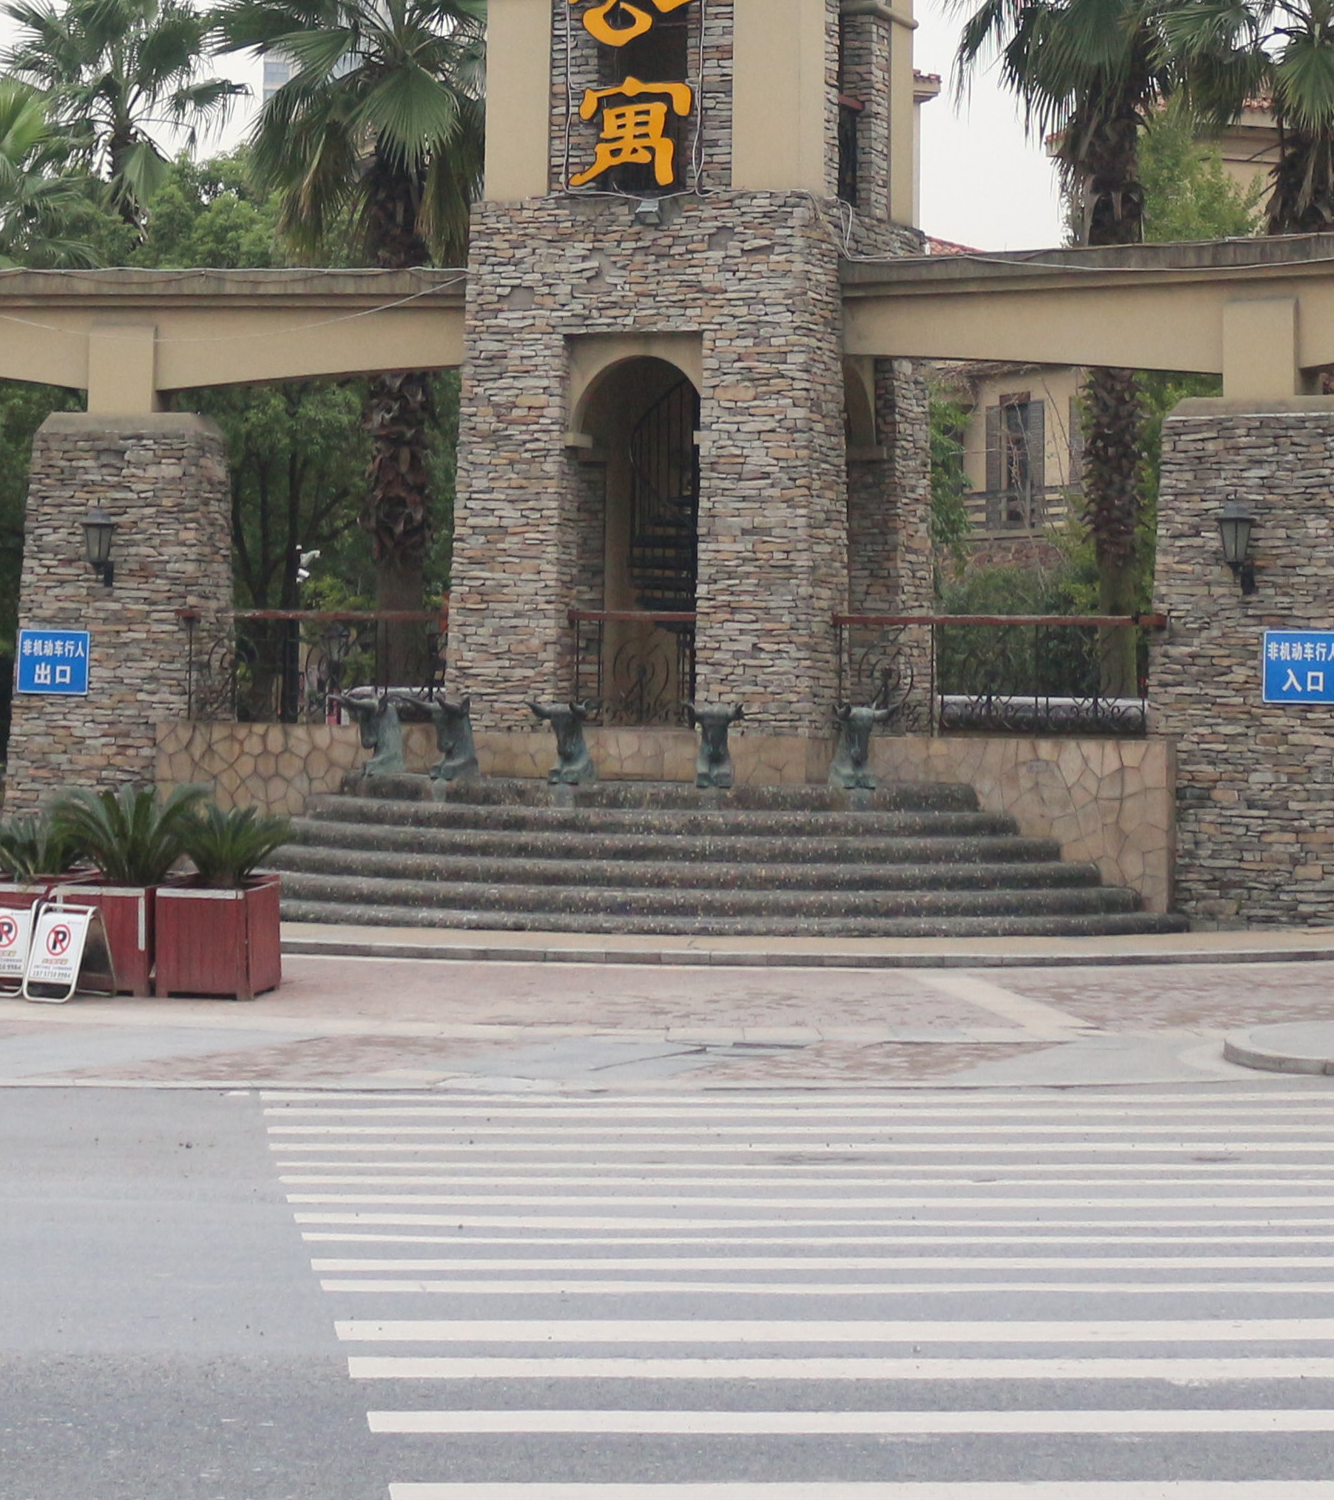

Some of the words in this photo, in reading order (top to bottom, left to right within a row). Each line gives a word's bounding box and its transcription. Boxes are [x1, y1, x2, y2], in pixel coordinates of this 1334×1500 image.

[22, 639, 85, 657] 非机动车行人
[34, 662, 71, 685] 出口
[1282, 668, 1324, 692] 入口
